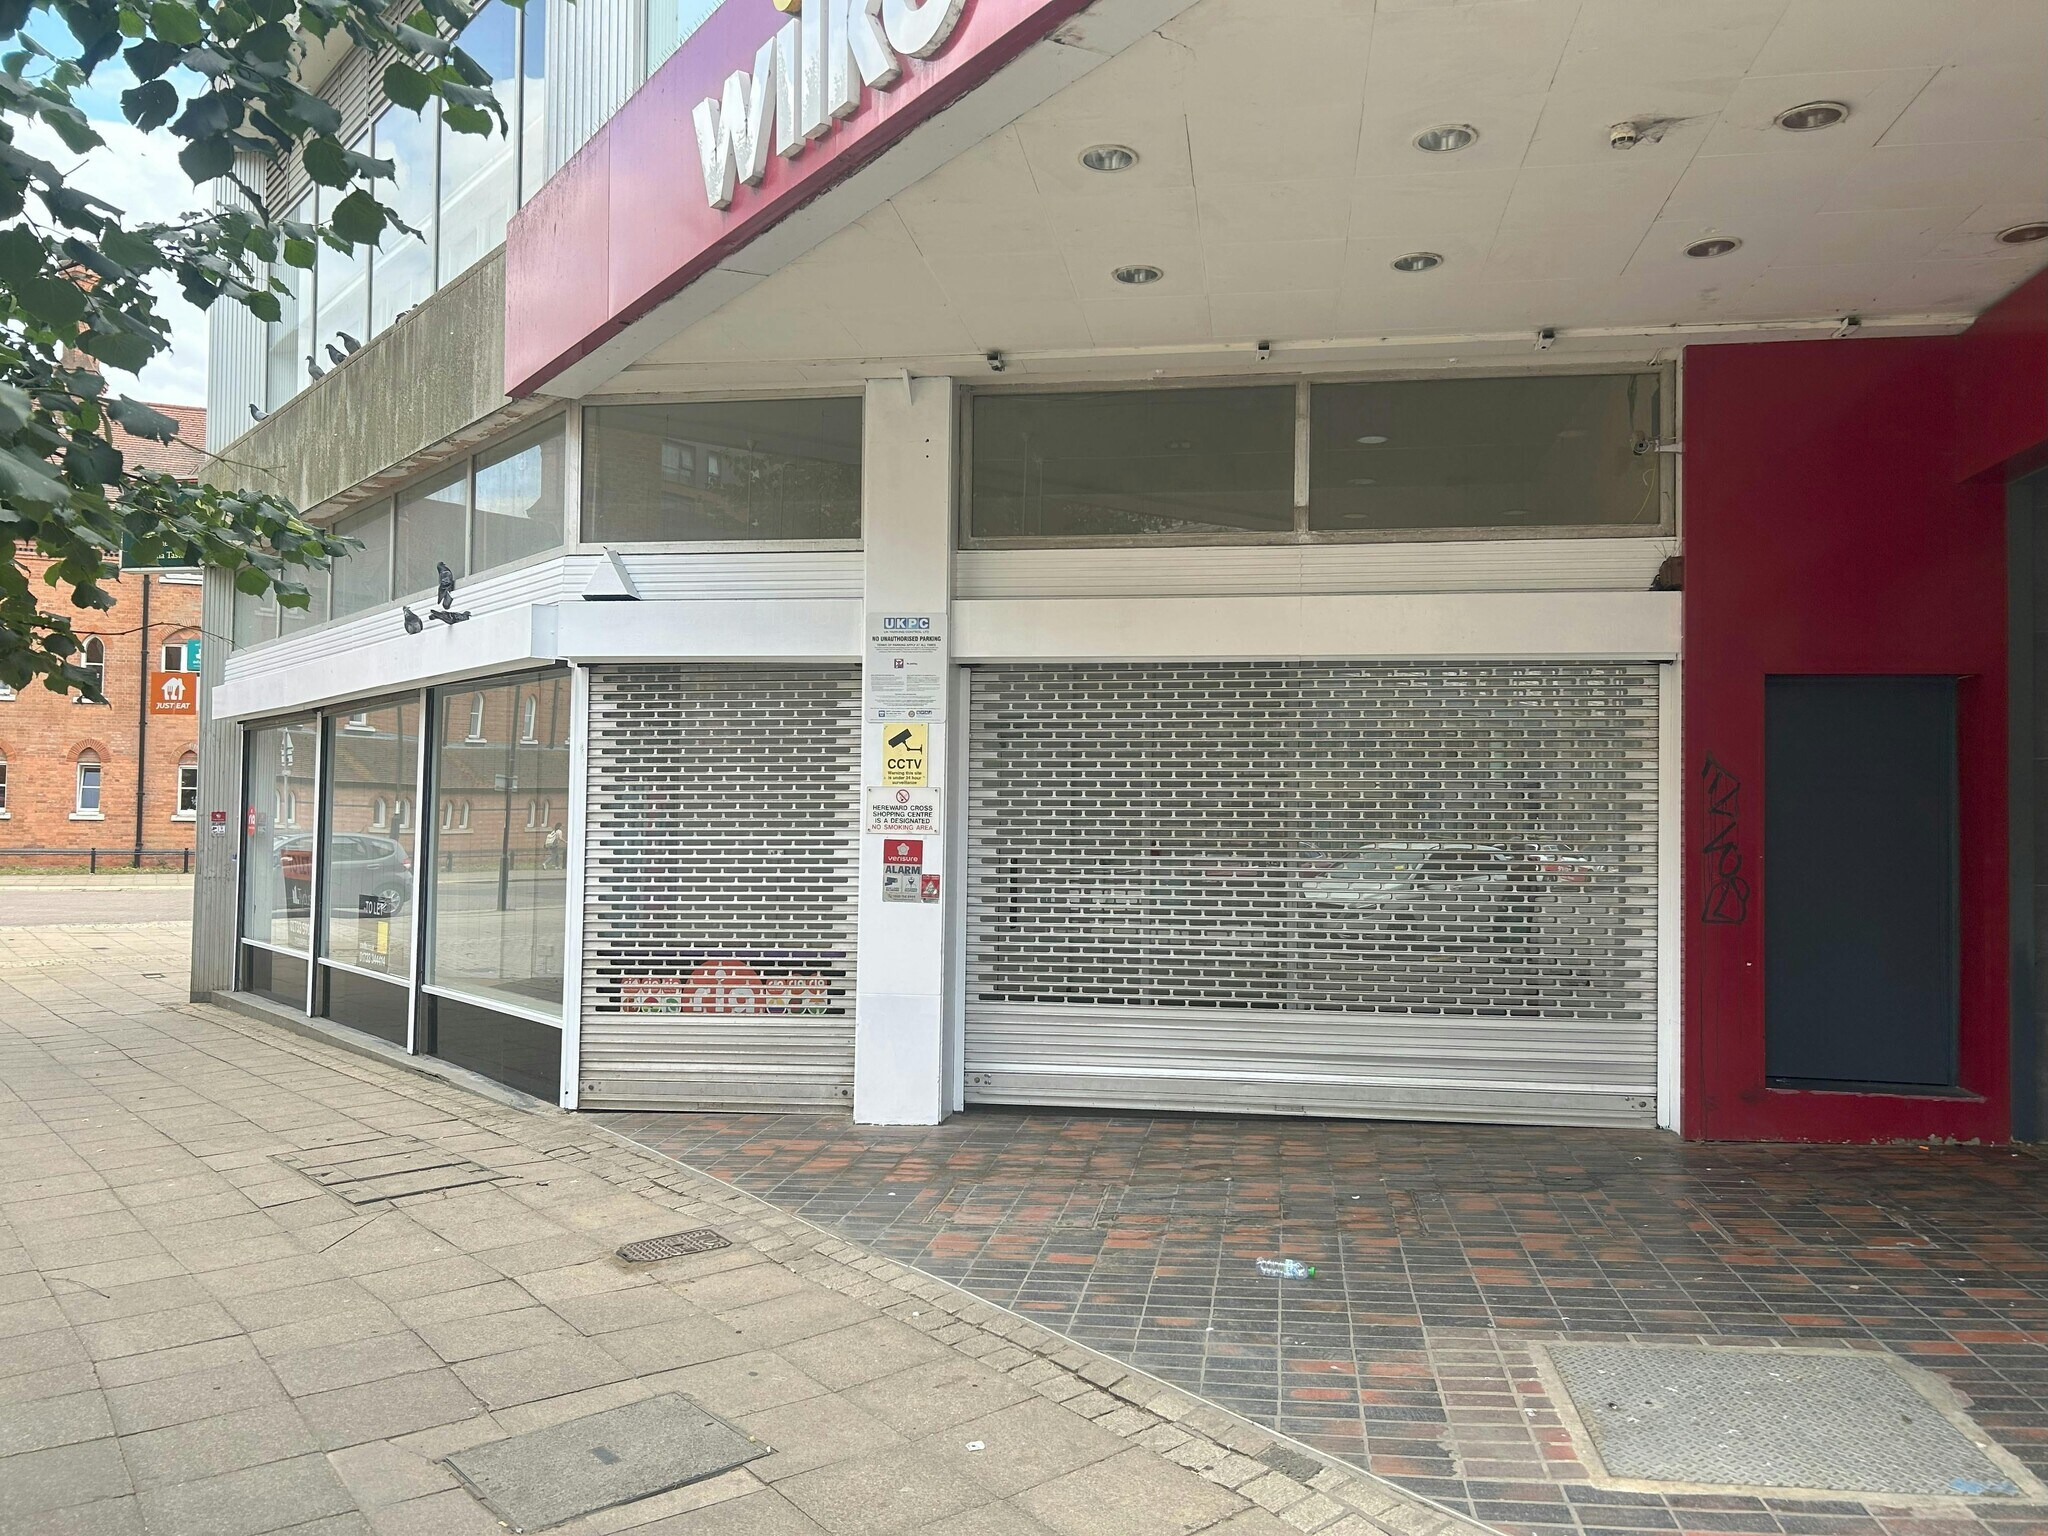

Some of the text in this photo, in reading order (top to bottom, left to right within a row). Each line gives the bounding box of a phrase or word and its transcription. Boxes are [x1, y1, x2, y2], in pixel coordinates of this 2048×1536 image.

[884, 617, 930, 630] UKPC
[156, 702, 175, 710] JUST
[887, 758, 922, 770] CCTV
[885, 865, 921, 875] ALARM
[365, 900, 384, 916] TO LET
